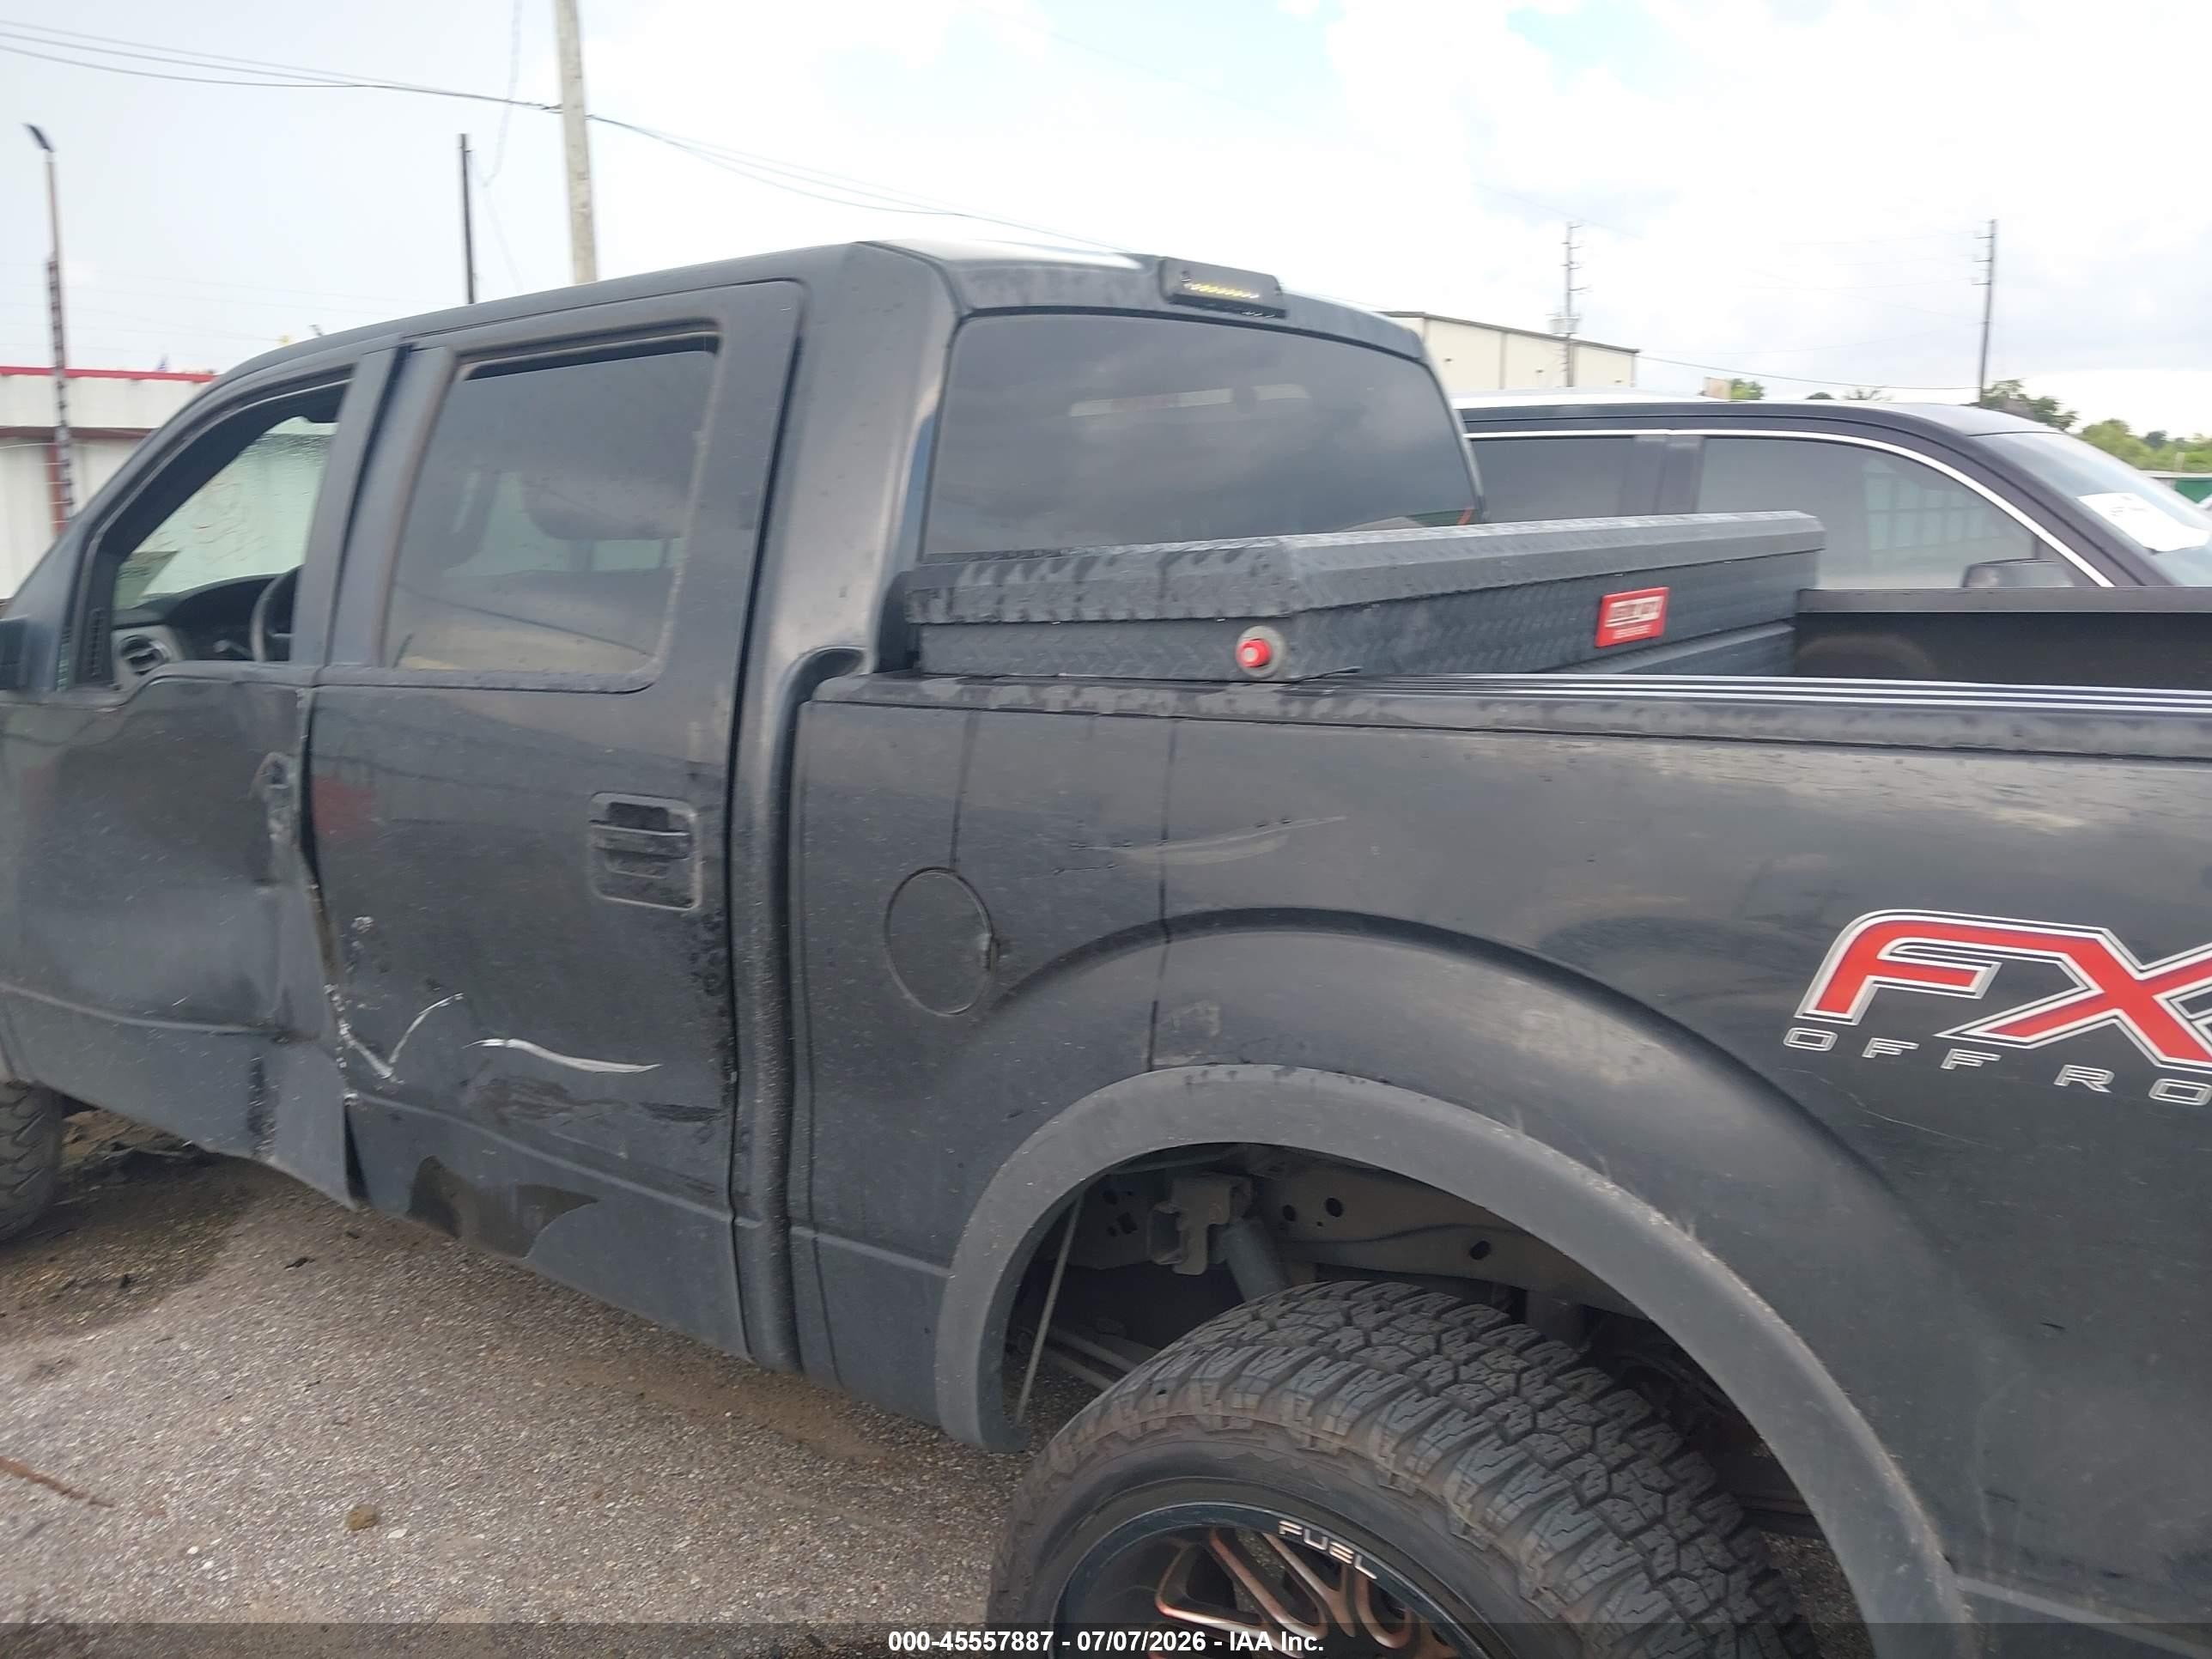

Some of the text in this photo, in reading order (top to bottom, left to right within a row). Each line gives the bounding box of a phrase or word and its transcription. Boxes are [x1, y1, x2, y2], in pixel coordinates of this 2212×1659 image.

[1794, 908, 2212, 1074] FX
[1783, 1027, 2212, 1106] OFF RO
[1278, 1520, 1378, 1580] FUEL
